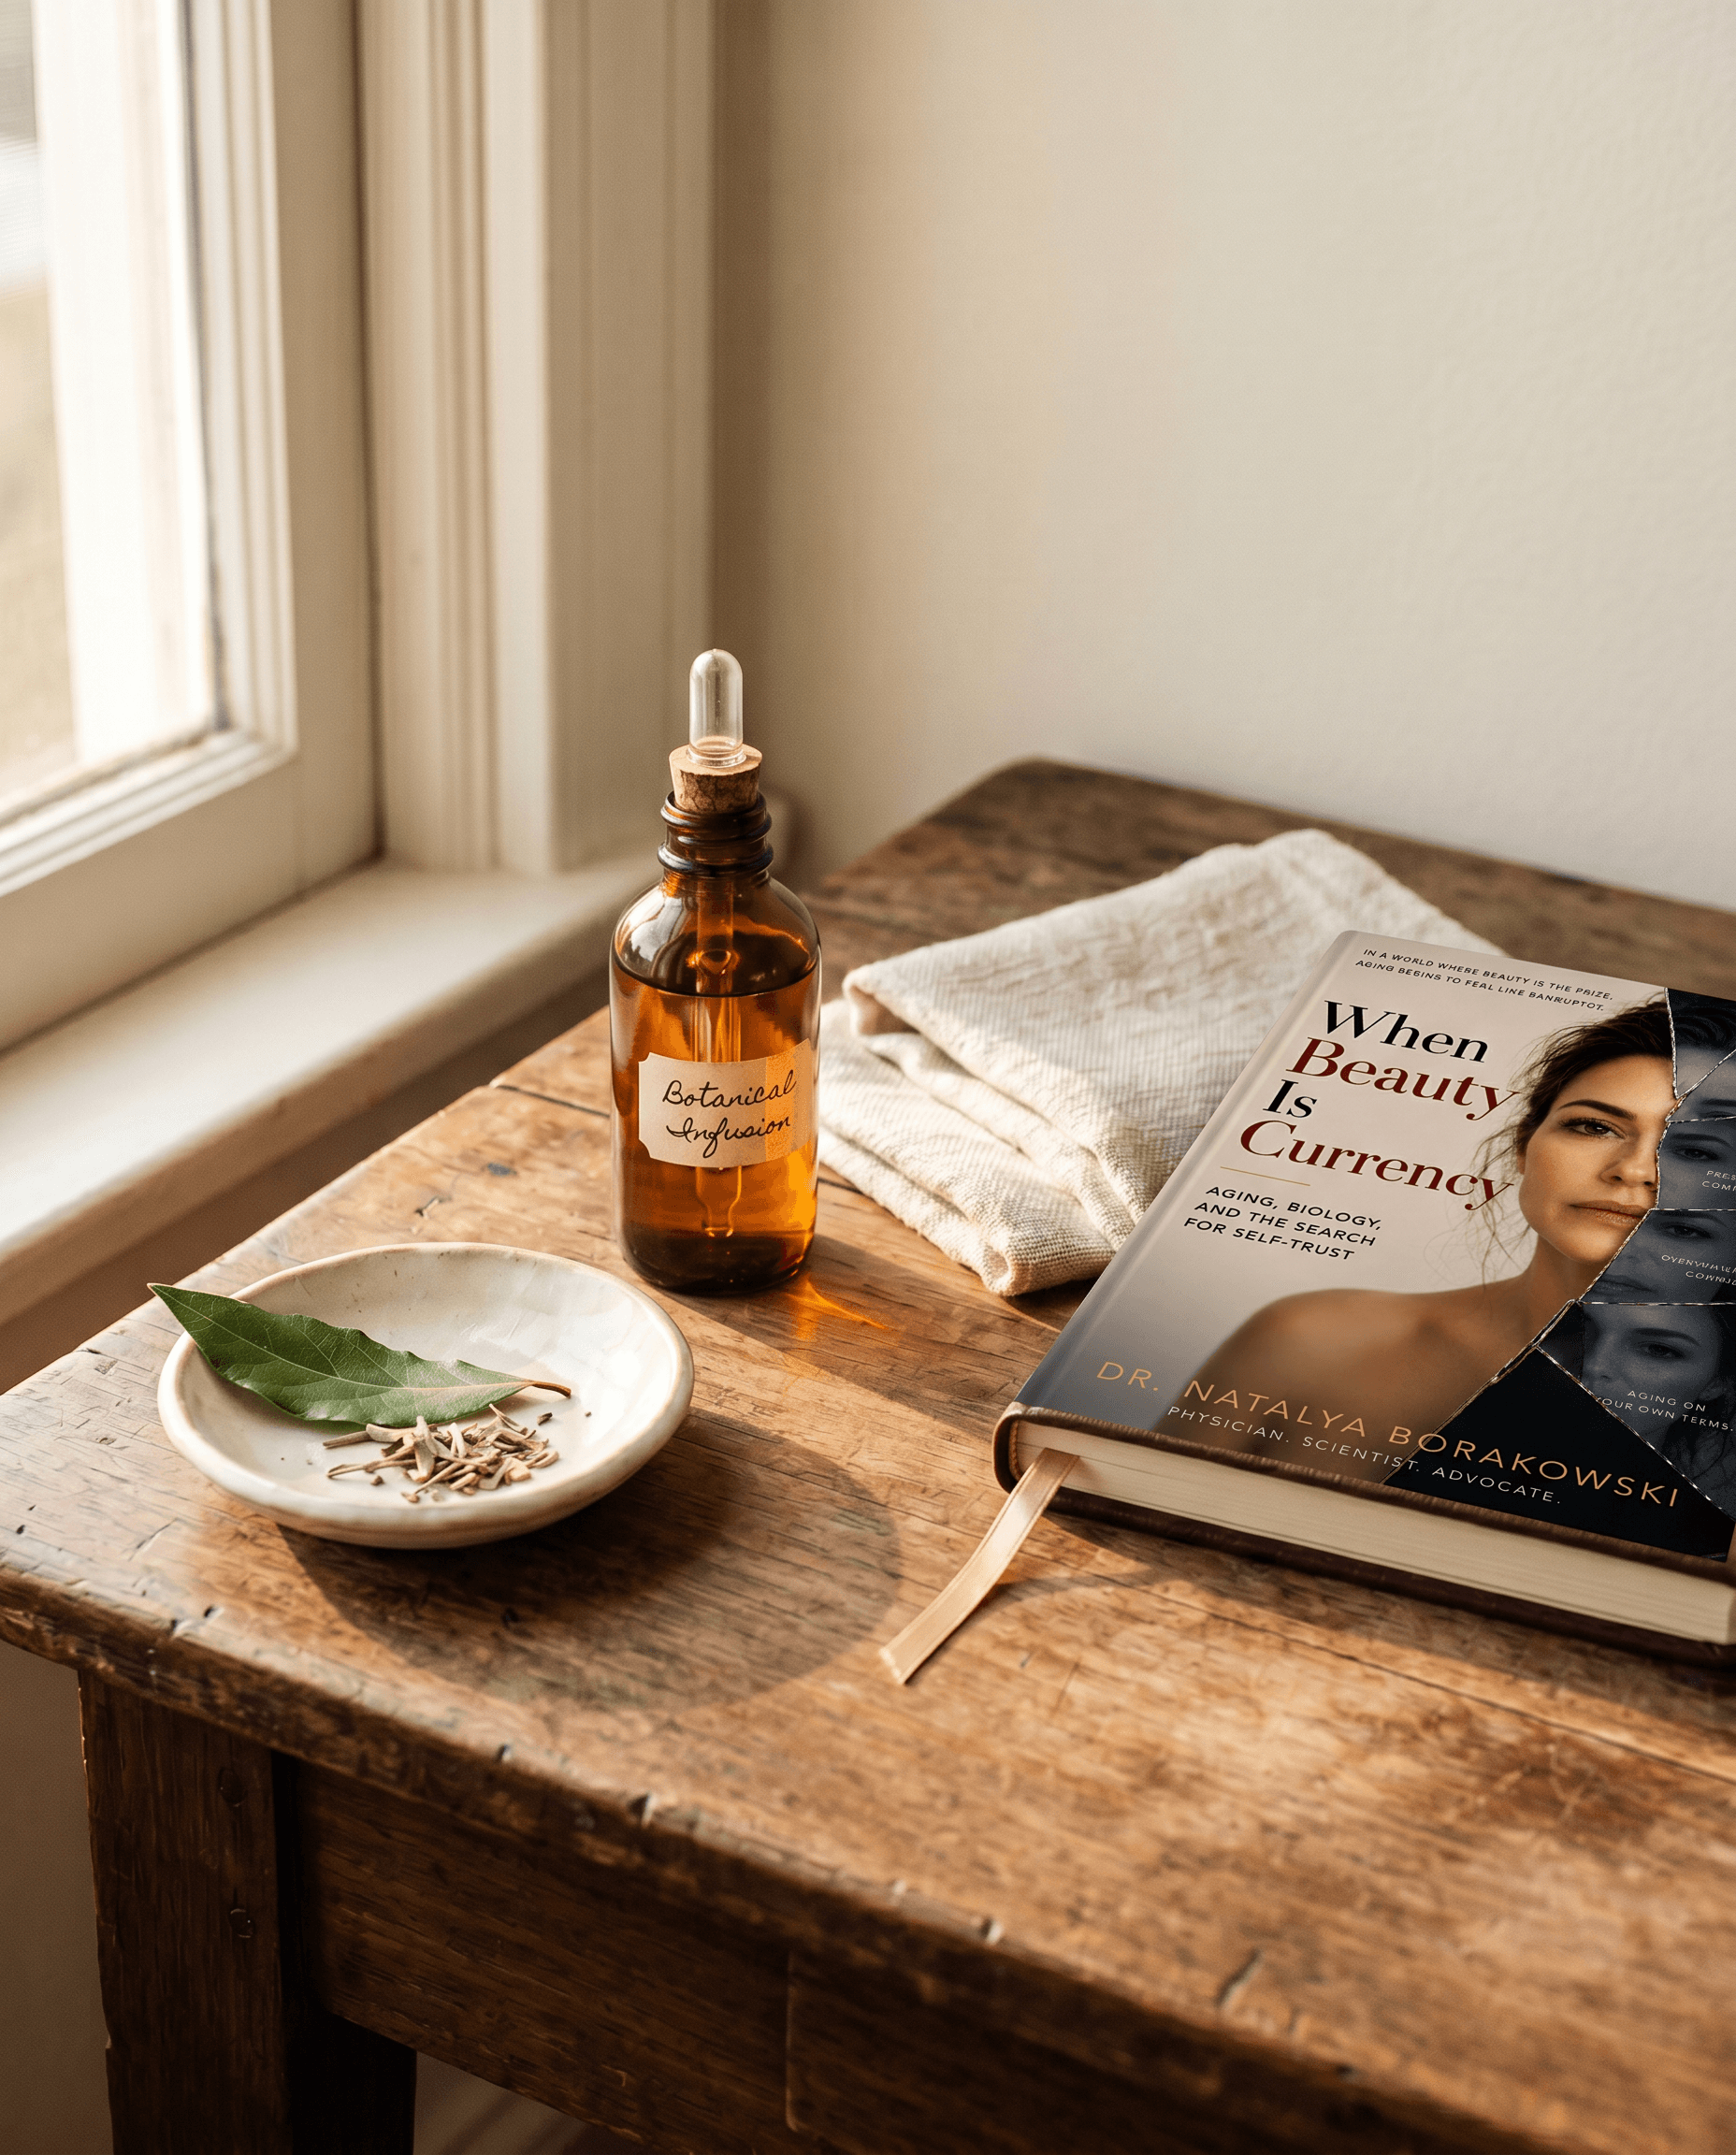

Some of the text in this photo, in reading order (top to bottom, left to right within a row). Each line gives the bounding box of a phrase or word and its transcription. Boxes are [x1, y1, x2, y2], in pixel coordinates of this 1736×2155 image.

[1355, 960, 1395, 972] AGING
[1445, 976, 1461, 984] TO
[1497, 986, 1526, 996] LINE
[1363, 948, 1377, 957] IN
[1391, 954, 1435, 967] WORLD
[1483, 970, 1531, 985] BEAUTY
[1533, 979, 1545, 988] IS
[1549, 982, 1572, 992] THE
[1324, 1000, 1489, 1063] When
[662, 1069, 797, 1107] Botanical
[1263, 1078, 1318, 1119] Is
[1285, 1036, 1522, 1121] Beauty
[666, 1116, 791, 1159] Infusion
[1240, 1120, 1514, 1211] Currency
[1194, 1202, 1376, 1247] AND THE SEARCH
[1206, 1186, 1382, 1231] AGING, BIOLOGY,
[1183, 1217, 1355, 1261] FOR SELF-TRUST
[1628, 1390, 1706, 1412] AGING ON
[1639, 1406, 1675, 1419] OWN
[1682, 1414, 1734, 1431] TERMS.
[1096, 1361, 1679, 1507] DR. NATALYA BORAKOWSKI
[1167, 1406, 1562, 1504] PHYSICIAN. SCIENTIST. ADVOCATE.
